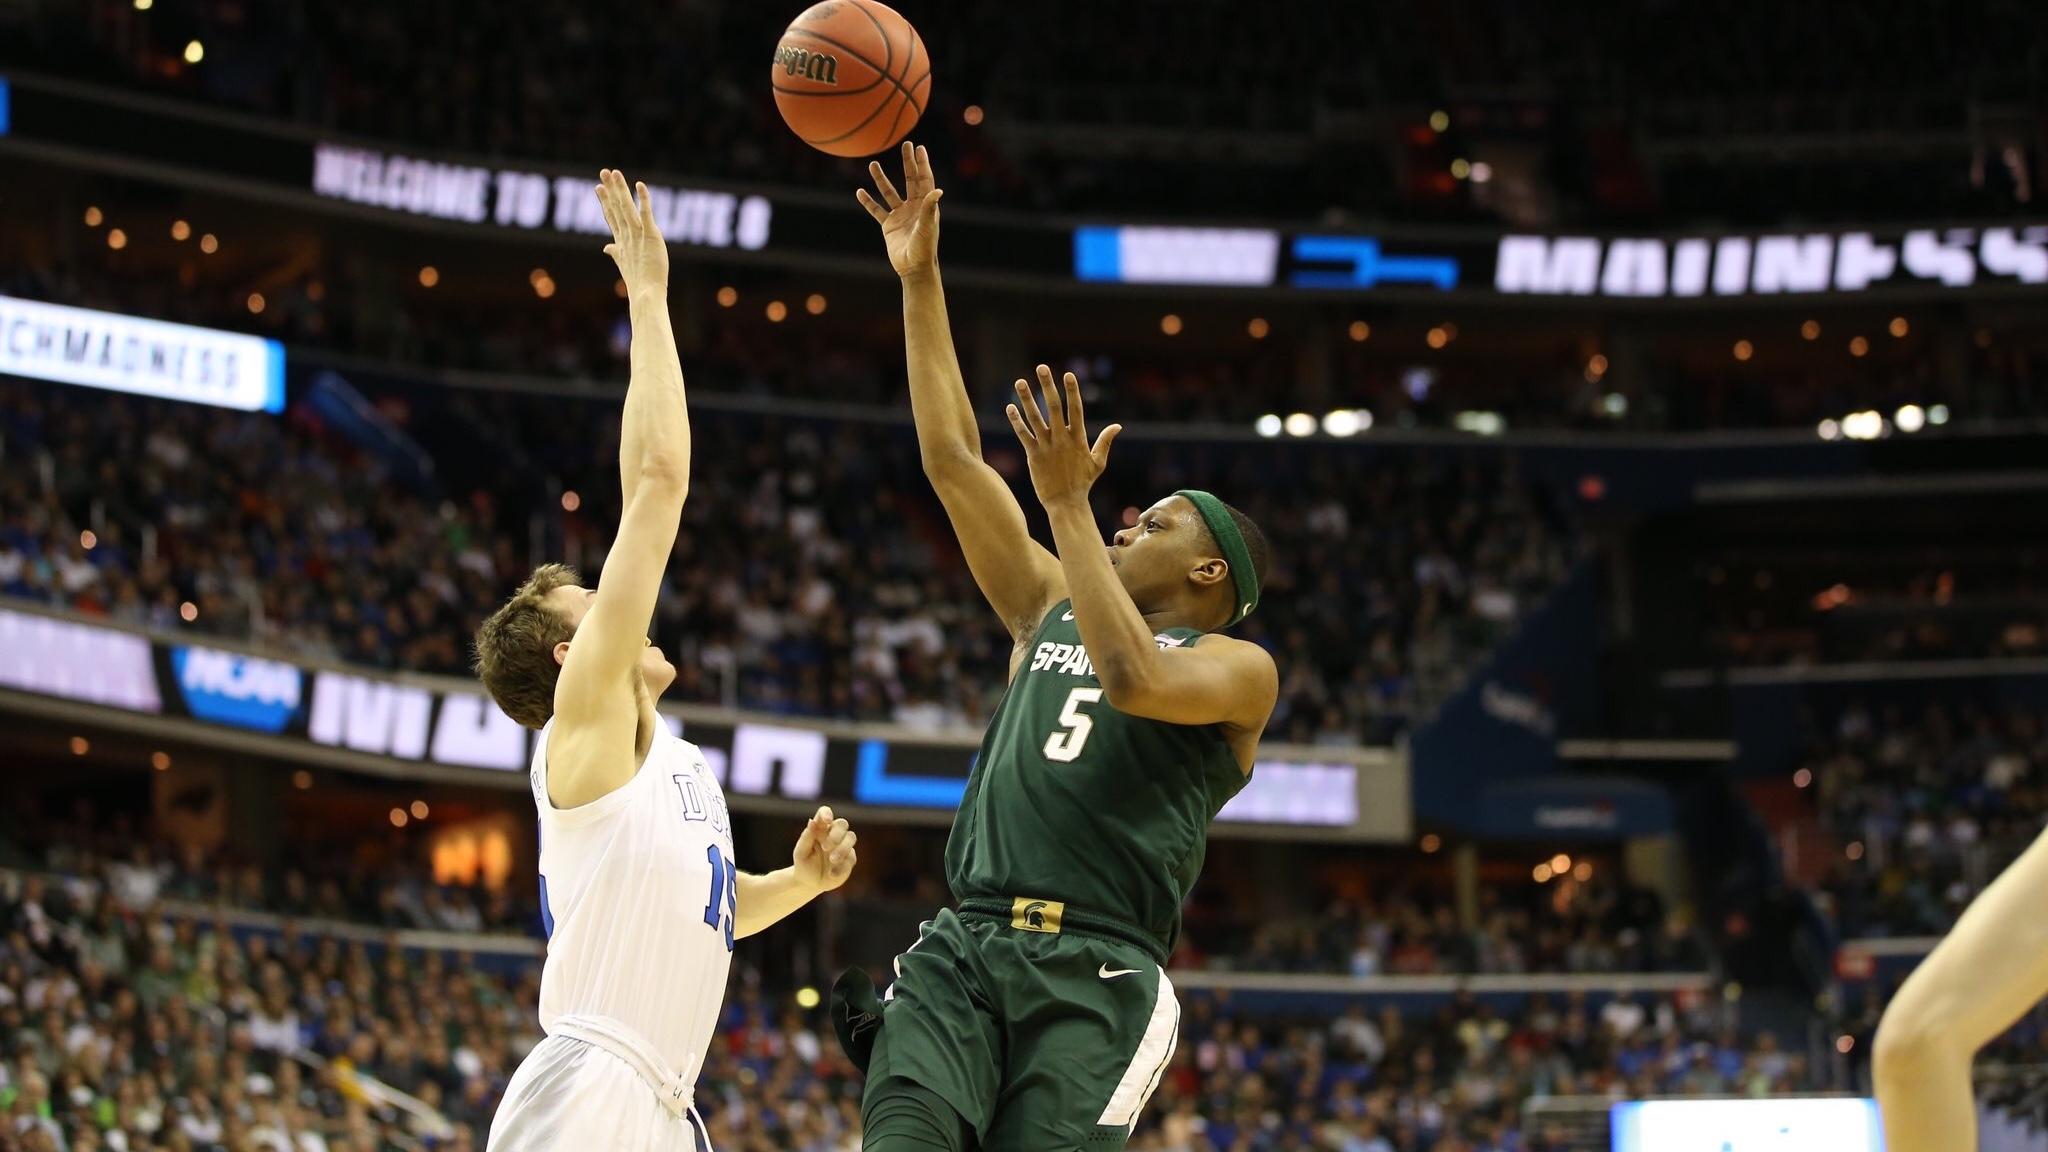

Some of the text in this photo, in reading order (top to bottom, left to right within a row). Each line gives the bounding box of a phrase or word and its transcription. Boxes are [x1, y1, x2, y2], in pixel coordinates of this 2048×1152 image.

[773, 45, 838, 86] Wilso
[314, 144, 489, 223] WELCOME
[495, 171, 550, 229] TO
[553, 176, 616, 236] TH
[0, 315, 239, 388] CHMADNESS
[1043, 687, 1105, 762] 5
[703, 843, 736, 952] 15
